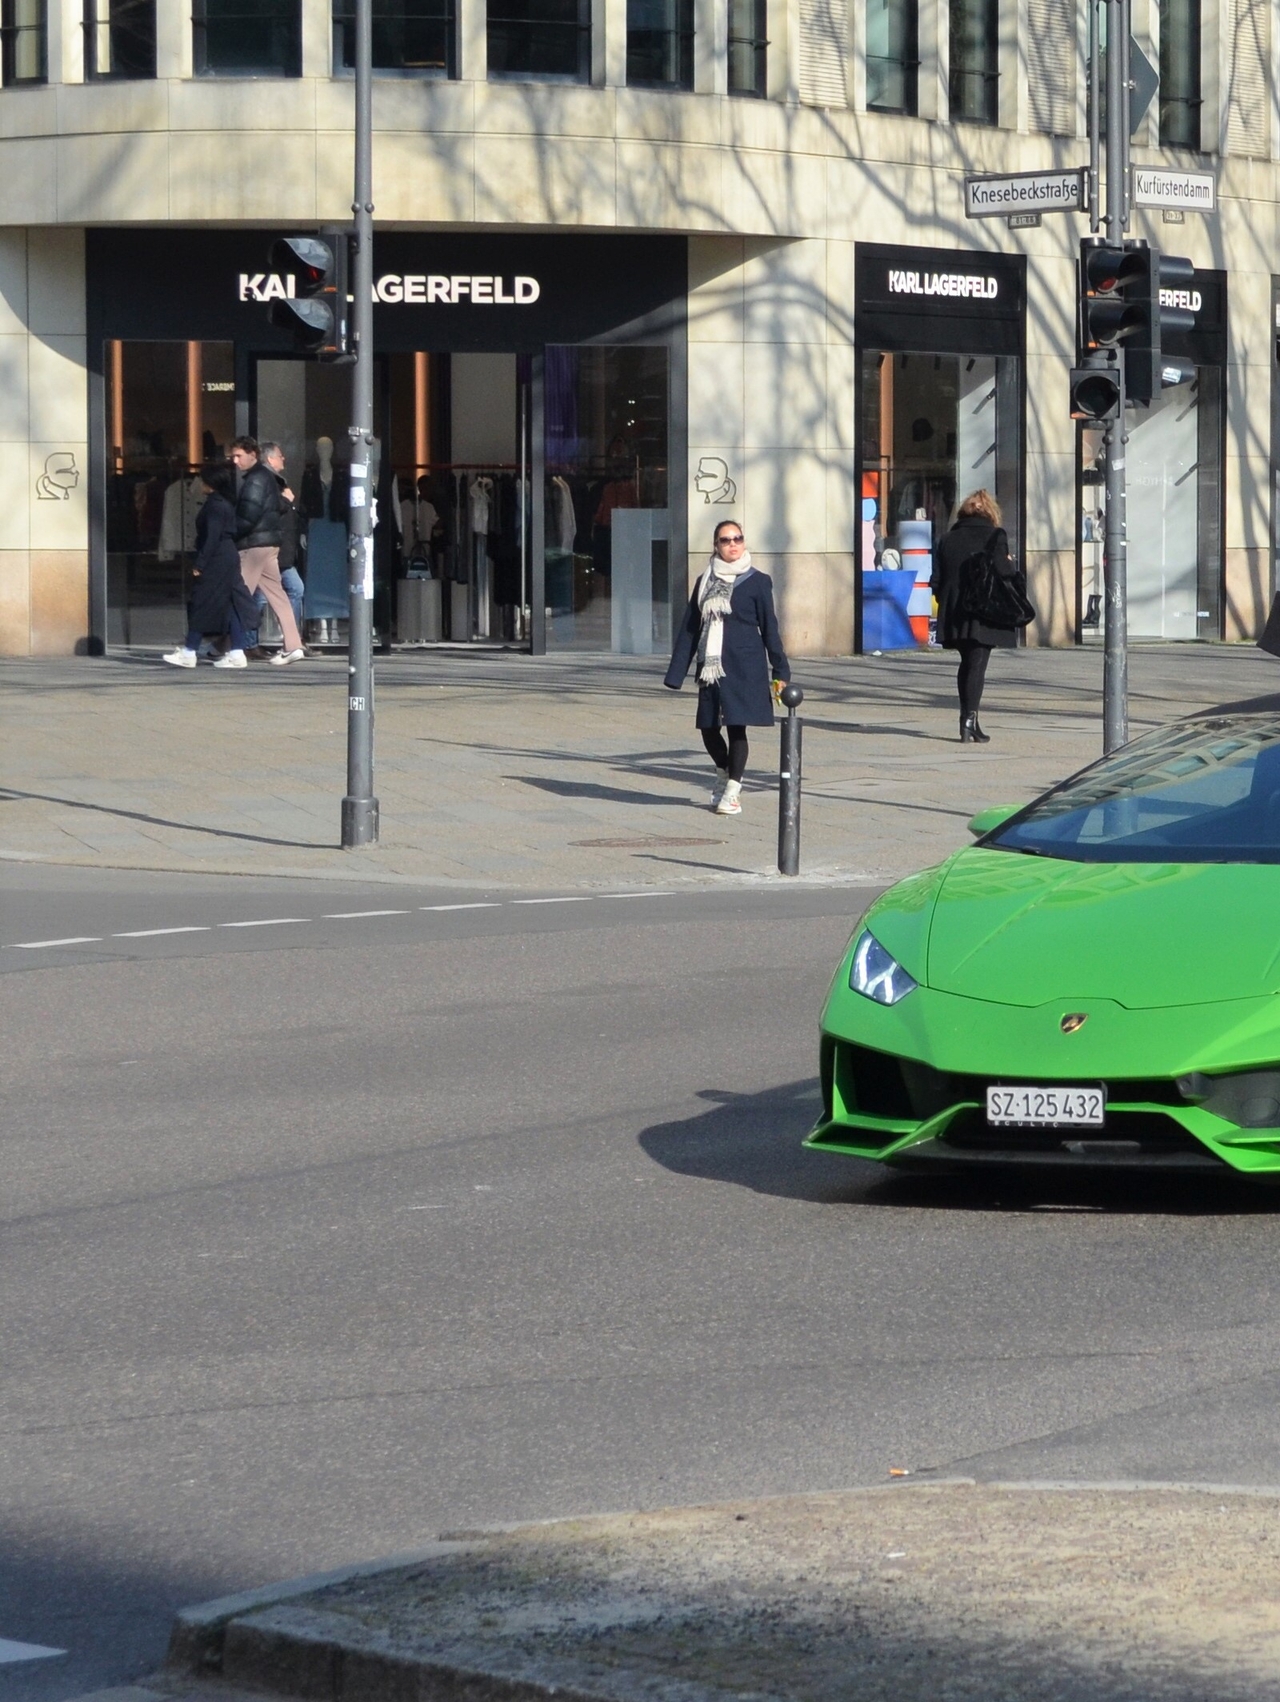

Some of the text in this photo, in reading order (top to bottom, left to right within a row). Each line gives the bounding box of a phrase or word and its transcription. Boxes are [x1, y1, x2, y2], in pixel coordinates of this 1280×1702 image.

[971, 178, 1078, 205] Knesebeckstraße
[1136, 175, 1210, 199] Kurfürstendamm
[239, 274, 541, 304] KA GERFELD
[888, 270, 998, 299] KARL LAGERFELD
[1158, 288, 1202, 312] ERFELD
